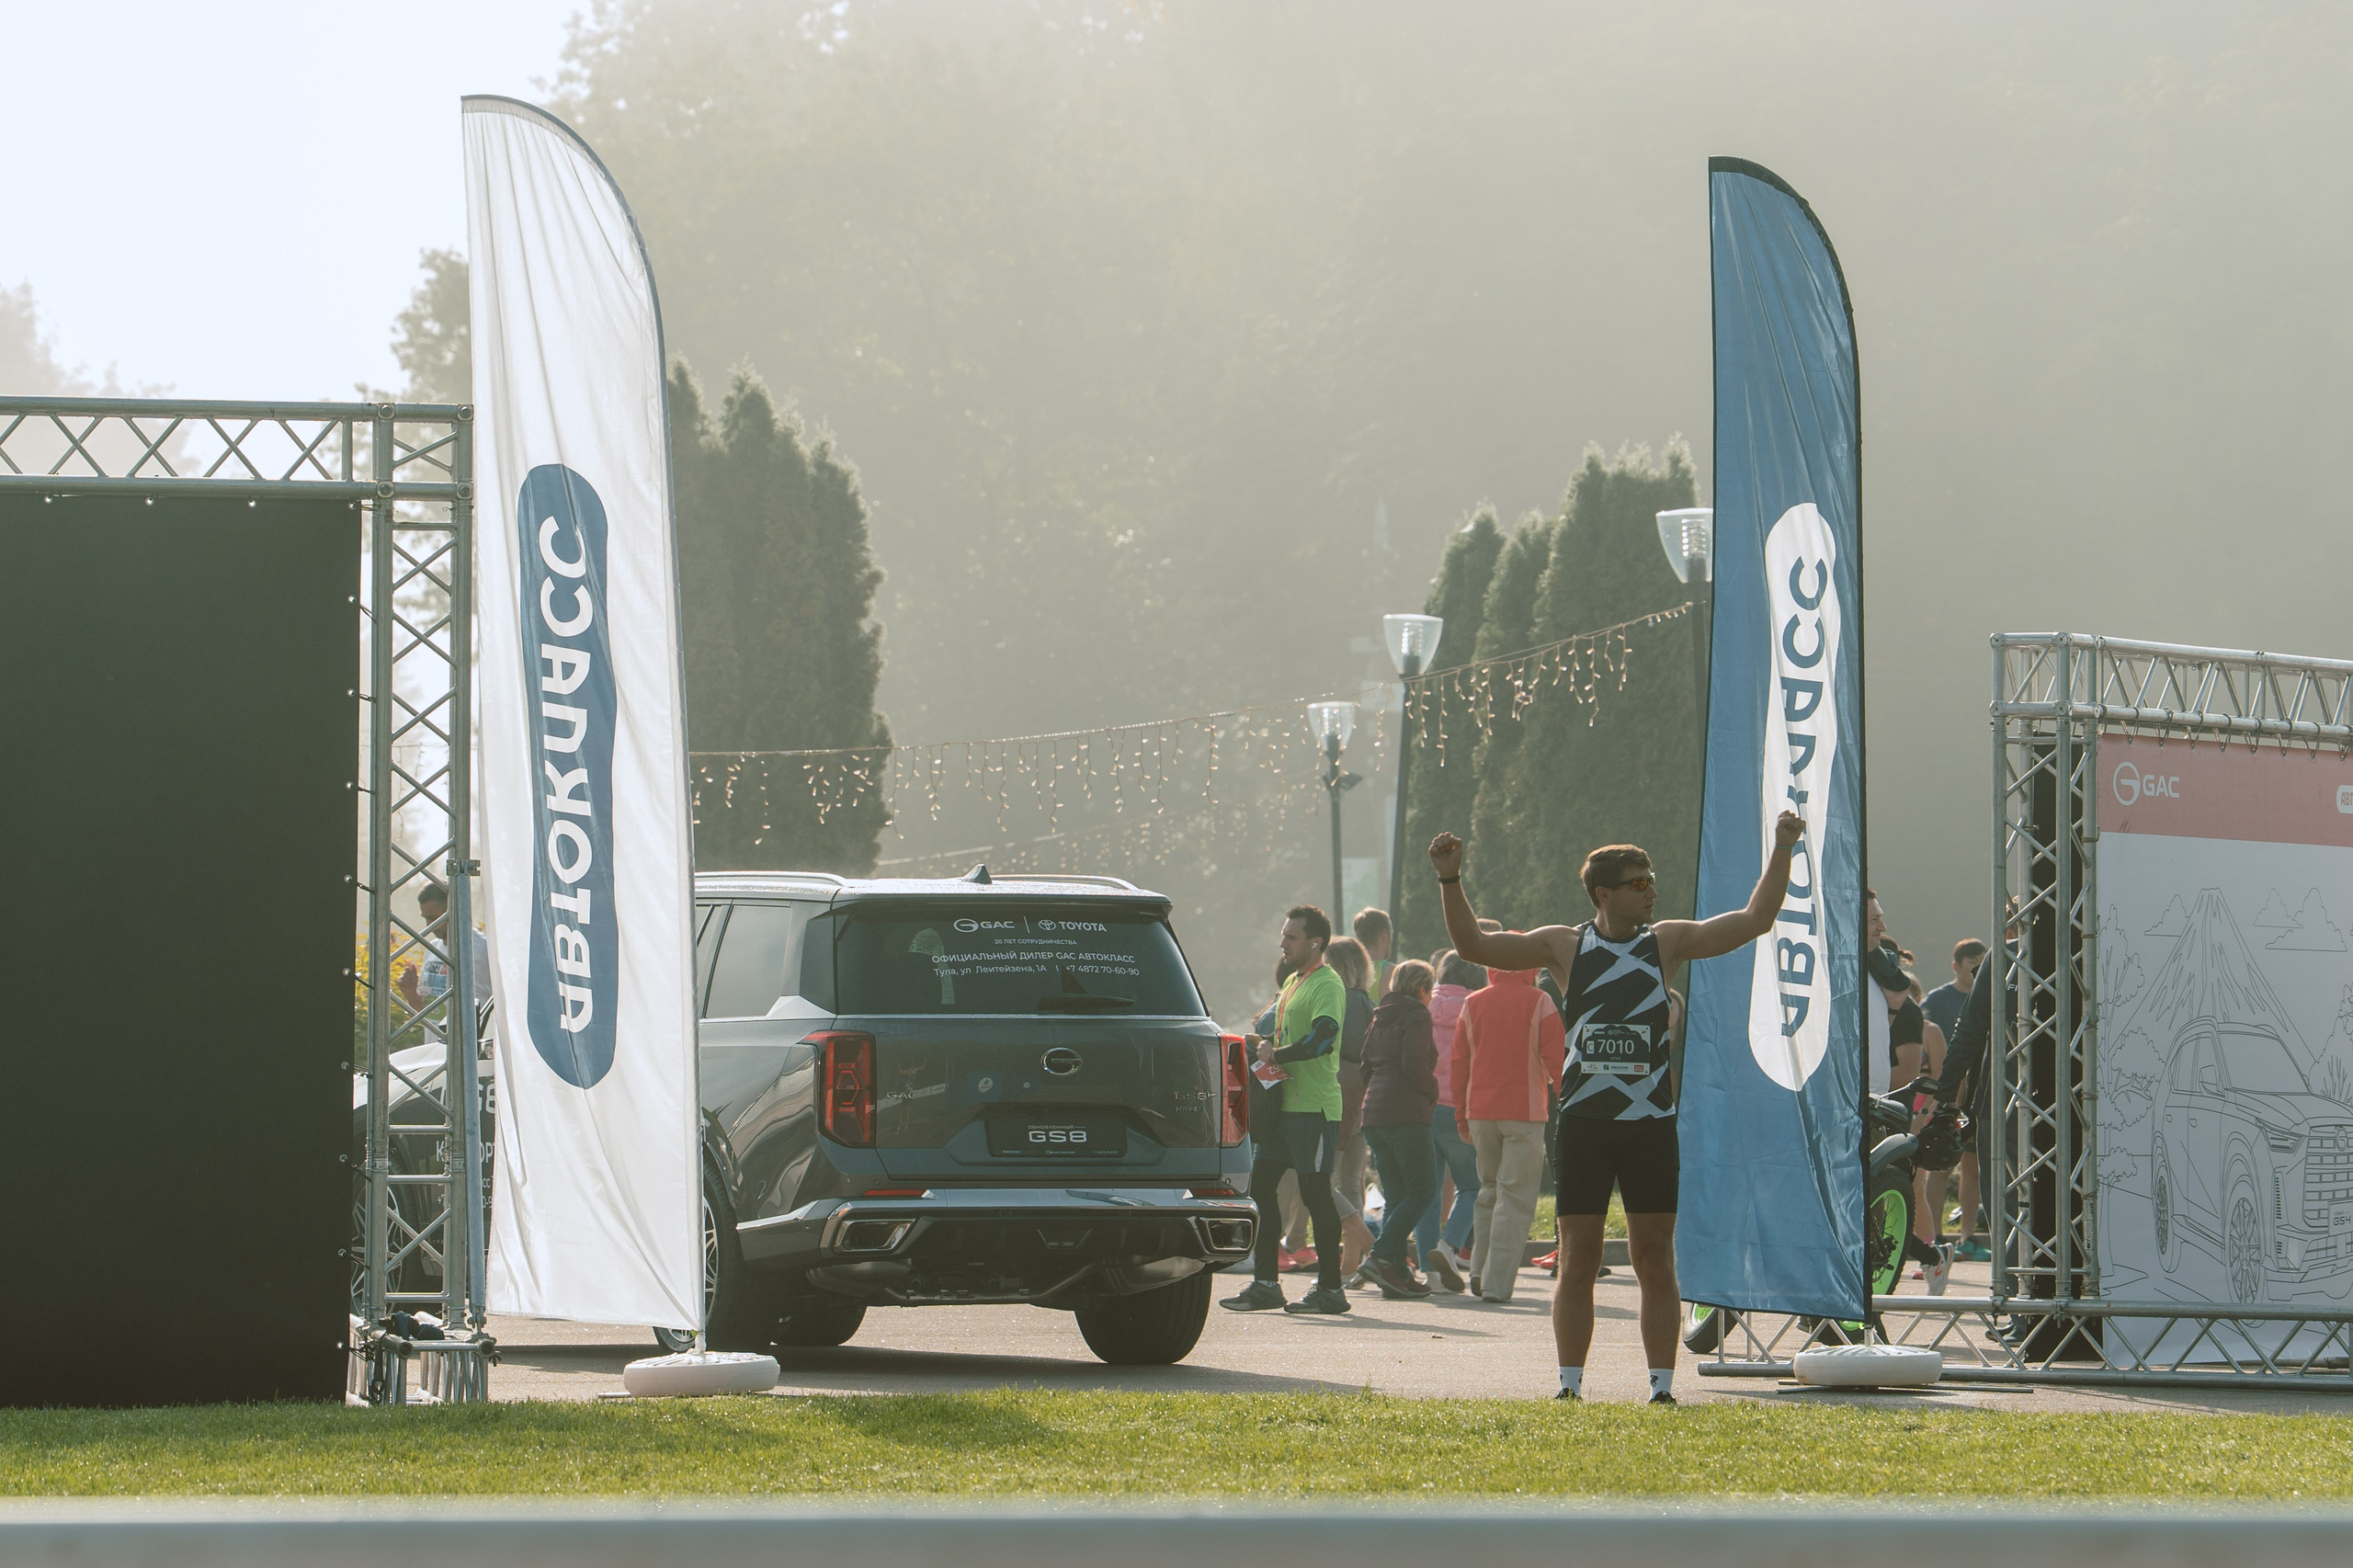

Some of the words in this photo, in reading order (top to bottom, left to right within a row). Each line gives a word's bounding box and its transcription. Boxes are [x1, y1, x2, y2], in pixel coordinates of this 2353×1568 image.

[2143, 774, 2180, 798] GAC
[980, 920, 1016, 929] GAC
[1059, 921, 1108, 933] TOYOTA
[931, 950, 1017, 963] ОФИЦИАЛЬНЫЙ
[1019, 951, 1053, 960] ДИЛЕР
[1055, 952, 1076, 960] GAC
[1078, 952, 1136, 963] АВТОКЛАСС
[933, 968, 959, 978] Тула,
[1065, 964, 1075, 972] +7
[1077, 965, 1100, 973] 4872
[1101, 966, 1140, 976] 70-60-90
[1597, 1039, 1635, 1054] 7010
[1028, 1131, 1087, 1143] GS8
[2333, 1215, 2351, 1225] GS4
